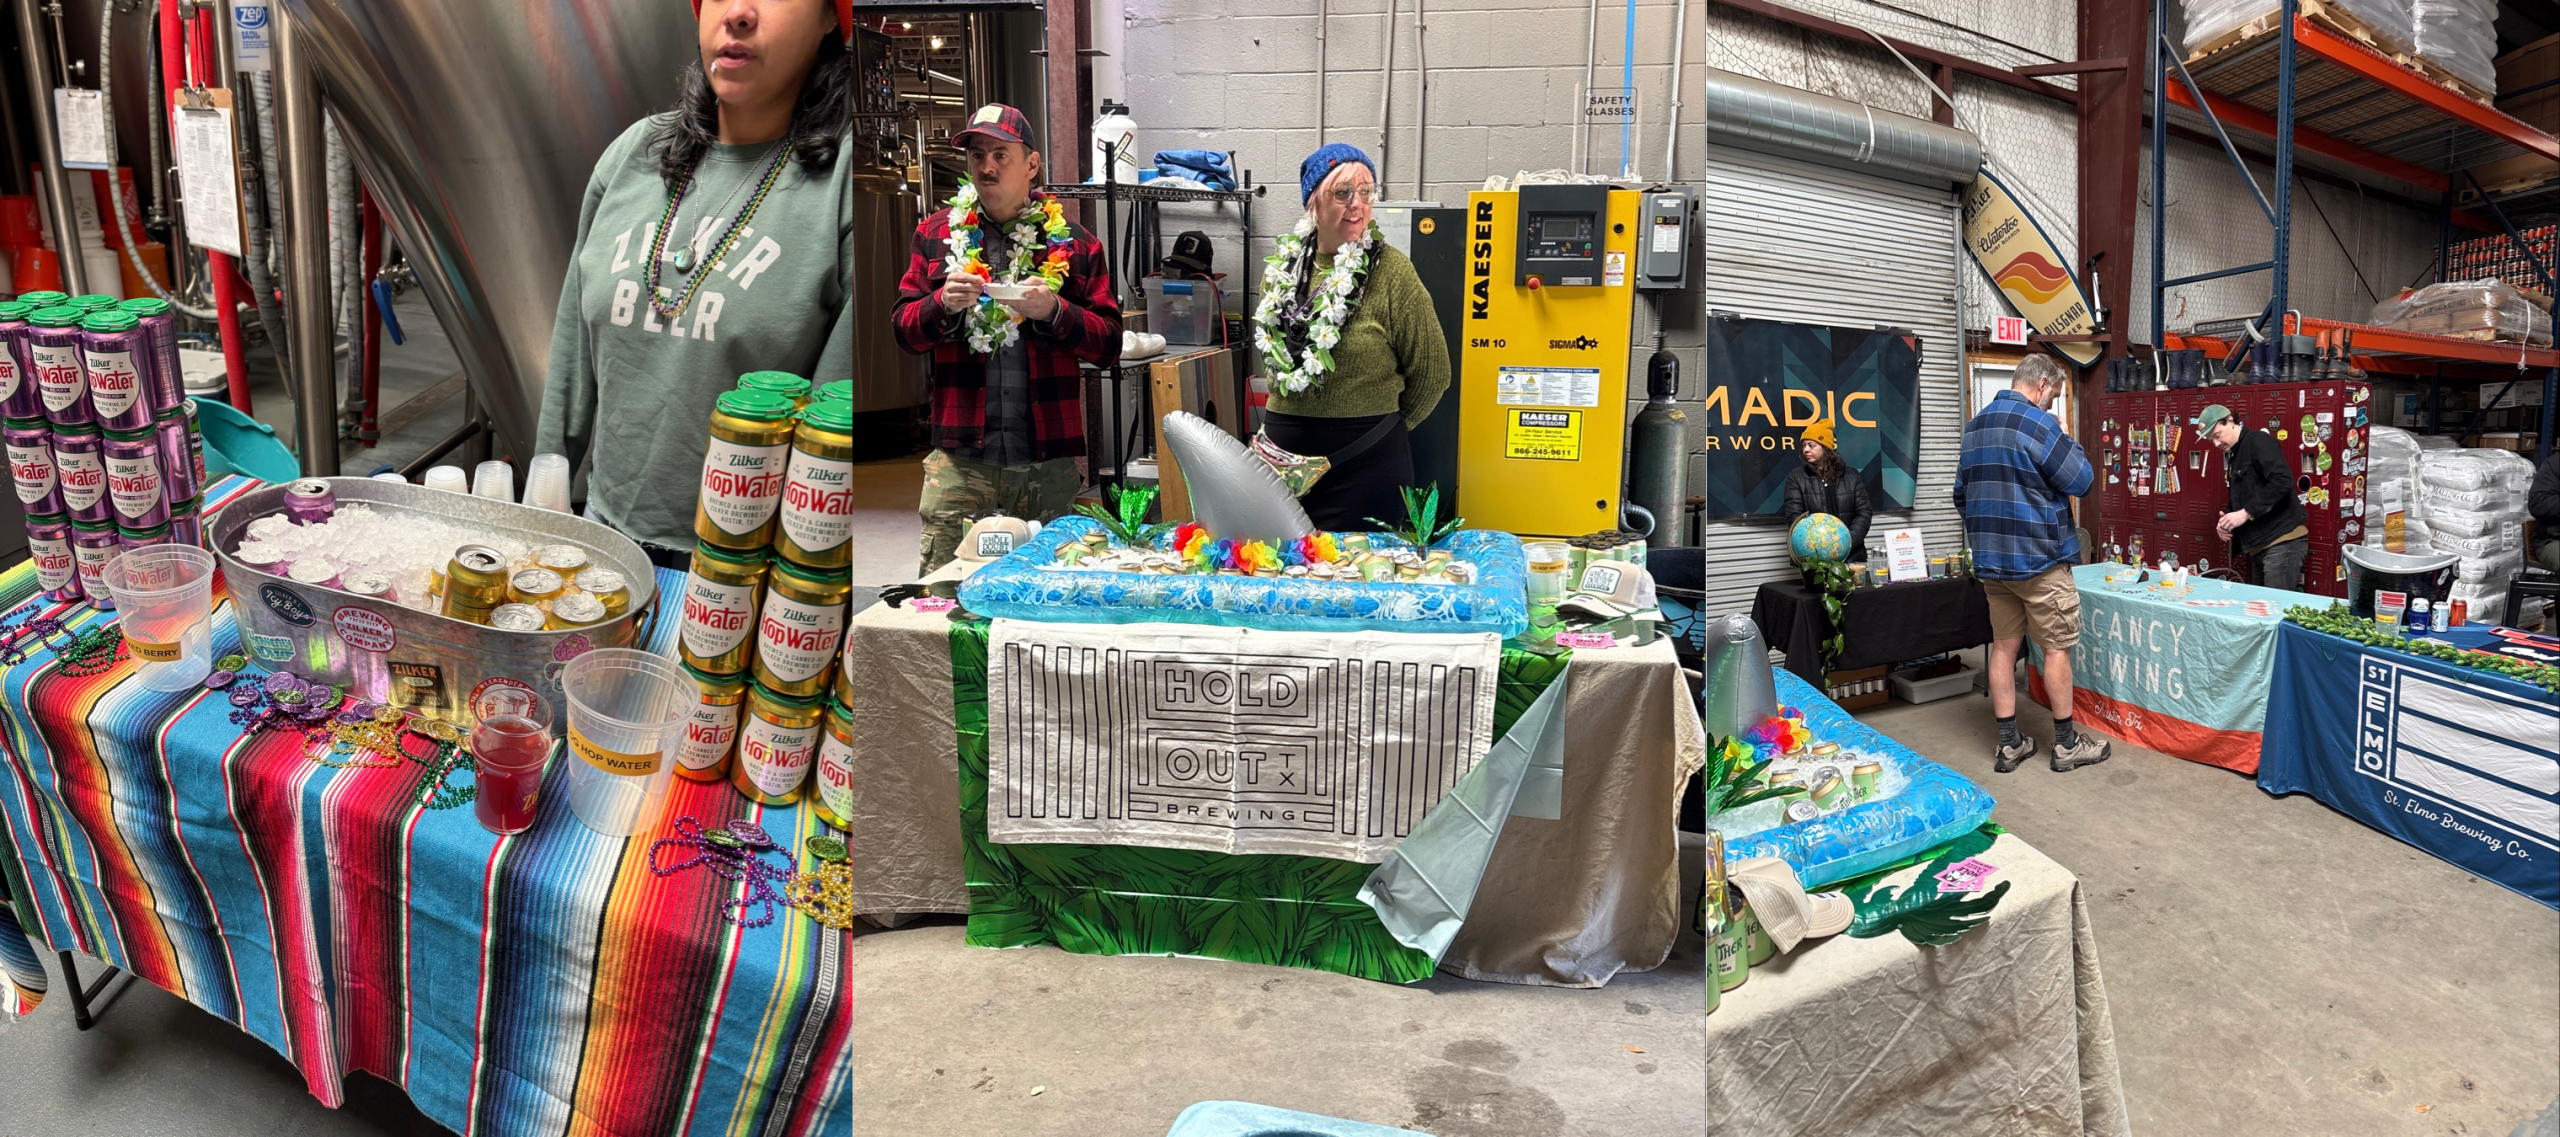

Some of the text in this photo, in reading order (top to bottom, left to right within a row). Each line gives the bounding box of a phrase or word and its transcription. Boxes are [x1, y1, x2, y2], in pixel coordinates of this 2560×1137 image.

[1590, 96, 1632, 105] SAFETY
[1585, 108, 1635, 116] GLASSES
[1979, 215, 2019, 253] Waterloo
[1989, 228, 2021, 255] SURF BOARDS
[611, 216, 781, 290] ZILKER
[1472, 201, 1494, 320] KAESER
[2044, 301, 2086, 336] PILSGNAR
[1998, 317, 2023, 342] EXIT
[1471, 338, 1507, 348] SM 10
[1549, 339, 1577, 350] SIGMA
[1706, 386, 1876, 428] MADIC
[1521, 413, 1568, 421] KAESER
[1514, 448, 1571, 456] 866-245-9611
[729, 454, 767, 467] Zilker
[115, 464, 138, 474] Zilker
[806, 467, 848, 481] Zilker
[2432, 485, 2460, 500] MALTING
[721, 516, 744, 526] AUSTIN,
[795, 530, 818, 543] AUSTIN,
[805, 526, 836, 536] BREWING
[2433, 530, 2460, 546] MALTING
[83, 552, 105, 561] Zilker
[695, 584, 726, 600] Zilker
[266, 589, 309, 620] Icy Boys
[337, 610, 390, 632] BREWING
[783, 607, 821, 623] Zilker
[346, 622, 382, 637] ZILKER
[2079, 605, 2186, 657] ACANCY
[340, 628, 391, 649] COMPANY
[694, 634, 719, 646] BREWING
[144, 648, 177, 657] BERRY
[392, 664, 437, 679] ZILKER
[772, 662, 795, 674] AUSTIN,
[782, 660, 810, 669] BREWING
[2075, 643, 2184, 700] REWING
[2368, 665, 2388, 682] ST
[479, 678, 523, 690] WEEKENDER
[1164, 668, 1298, 709] HOLD
[2363, 691, 2386, 771] ELMO
[771, 733, 805, 745] Zilker
[581, 744, 603, 762] HOP
[607, 757, 652, 770] WATER
[679, 752, 697, 763] USTIN,
[686, 749, 710, 759] BREWING
[744, 735, 816, 769] HopWate
[1165, 748, 1267, 785] OUT
[1167, 803, 1295, 821] BREWING
[2384, 789, 2533, 862] St. Elmo Brewing Co.
